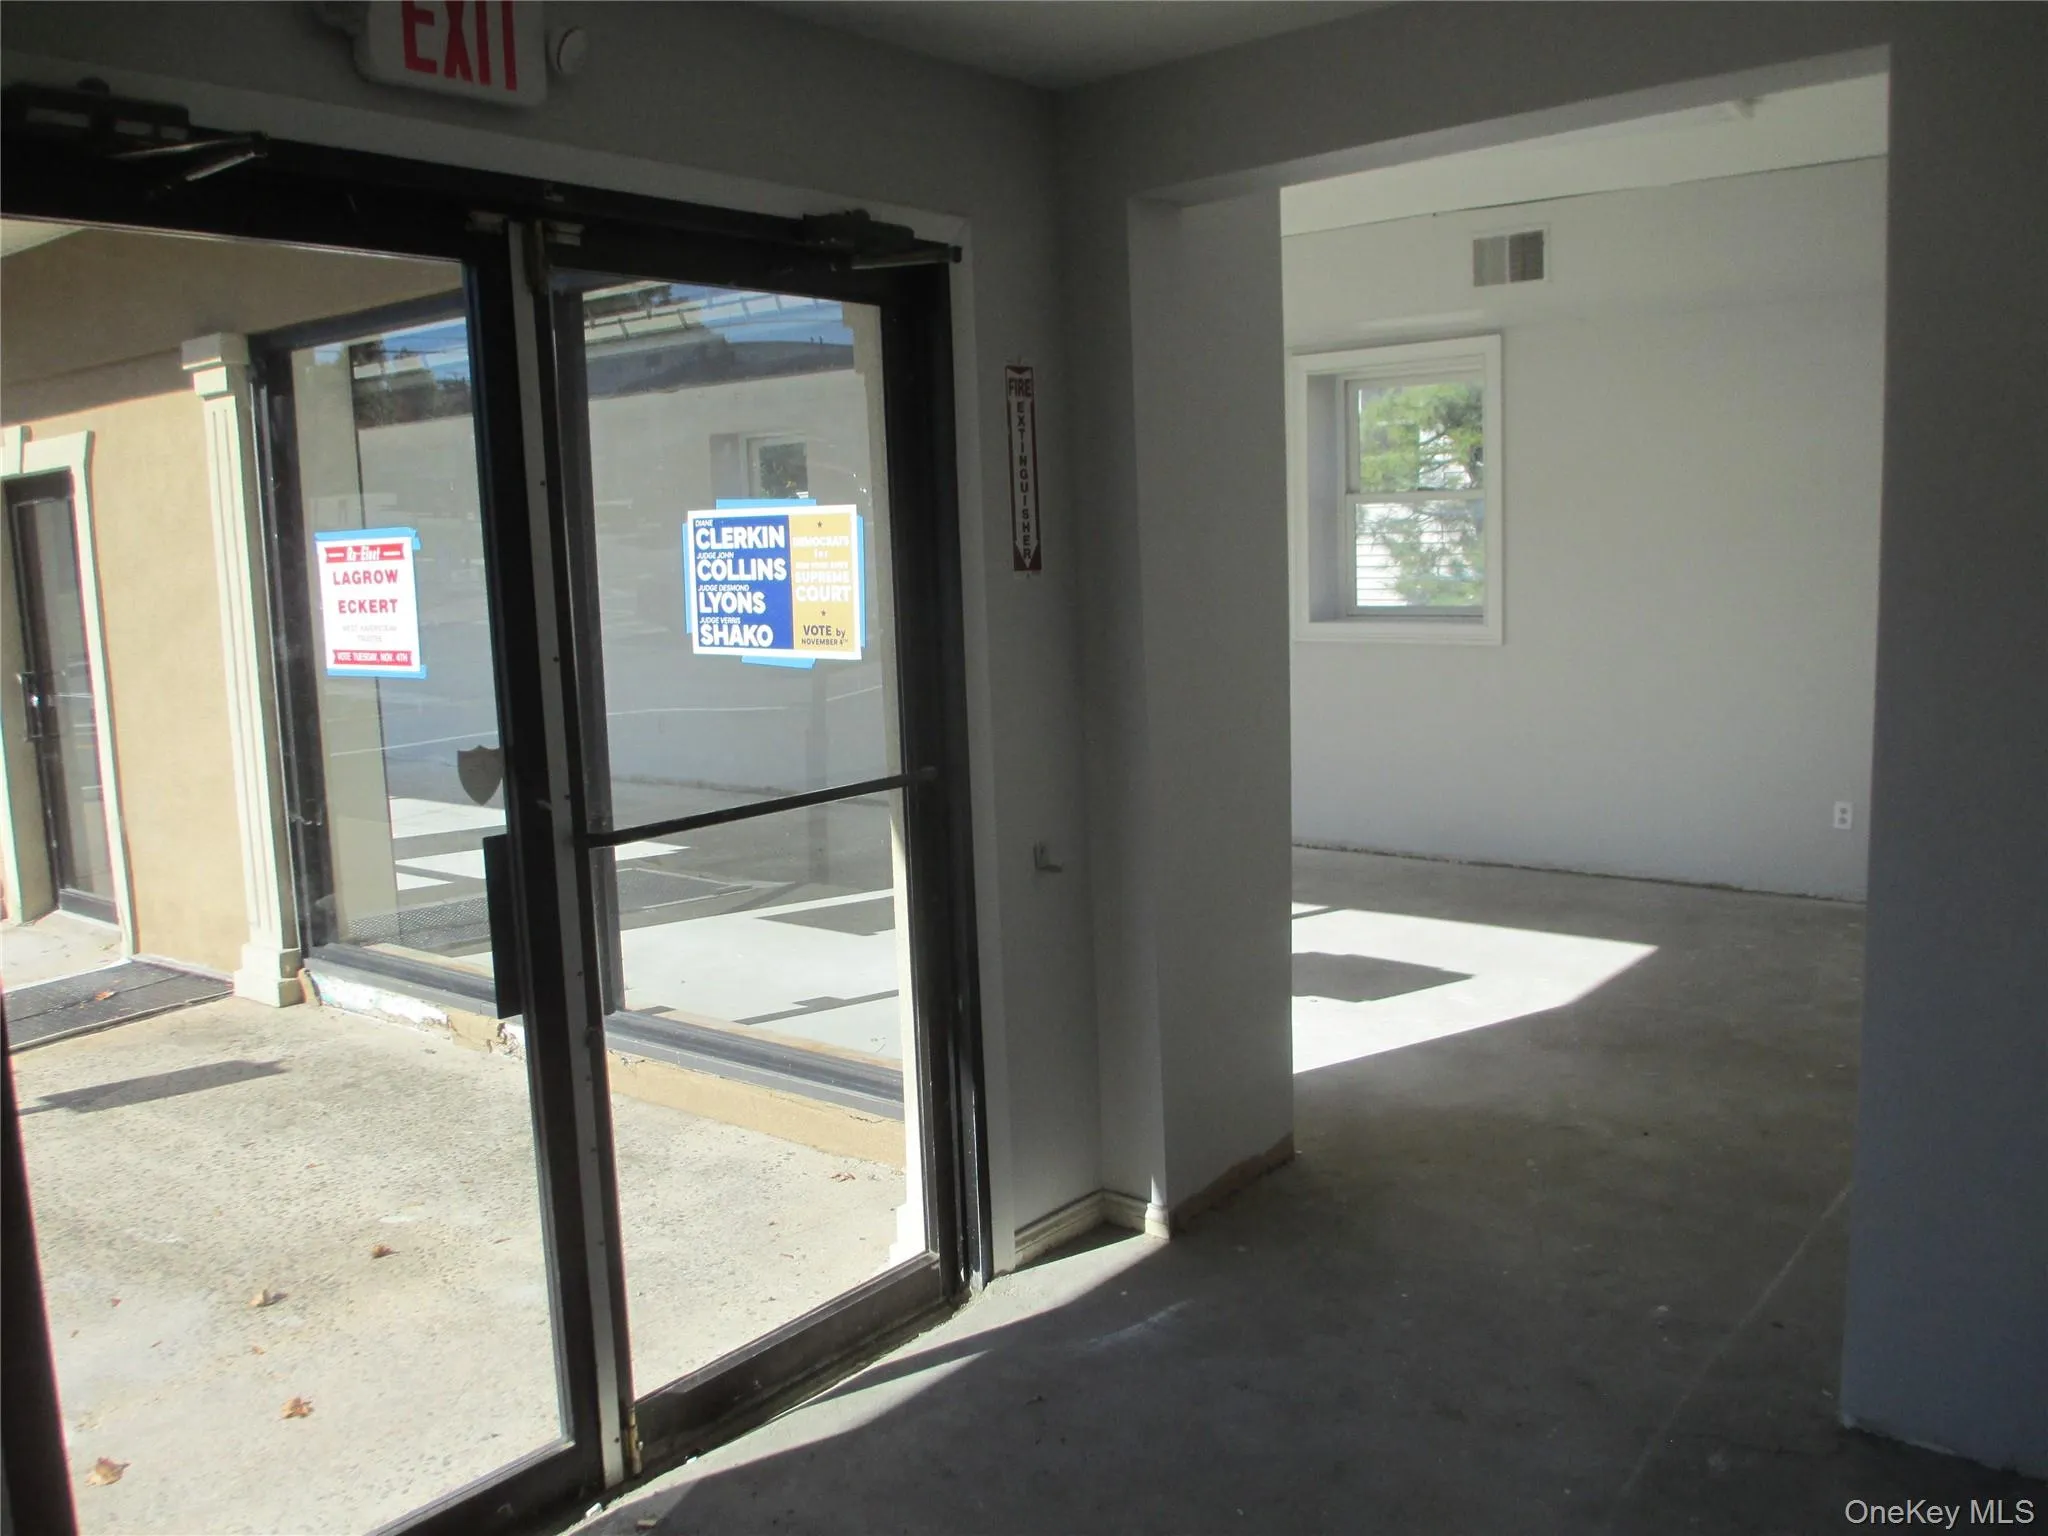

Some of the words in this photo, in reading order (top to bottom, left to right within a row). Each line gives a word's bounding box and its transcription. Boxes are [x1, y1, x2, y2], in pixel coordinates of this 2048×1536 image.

[1008, 378, 1032, 397] FIRE
[1016, 401, 1032, 559] EXTINGUISHER
[695, 519, 714, 527] DIANE
[695, 525, 785, 549] CLERKIN
[697, 552, 716, 560] JUDGE
[333, 569, 398, 585] LAGROW
[697, 558, 787, 581] COLLINS
[795, 571, 850, 585] SUPREME
[698, 584, 718, 592] JUDGE
[719, 584, 749, 592] DESMOND
[795, 585, 852, 602] COURT
[338, 599, 398, 614] ECKERT
[699, 591, 766, 614] LYONS
[700, 617, 719, 625] JUDGE
[701, 624, 773, 647] SHAKO
[803, 624, 832, 636] VOTE
[835, 628, 846, 638] by
